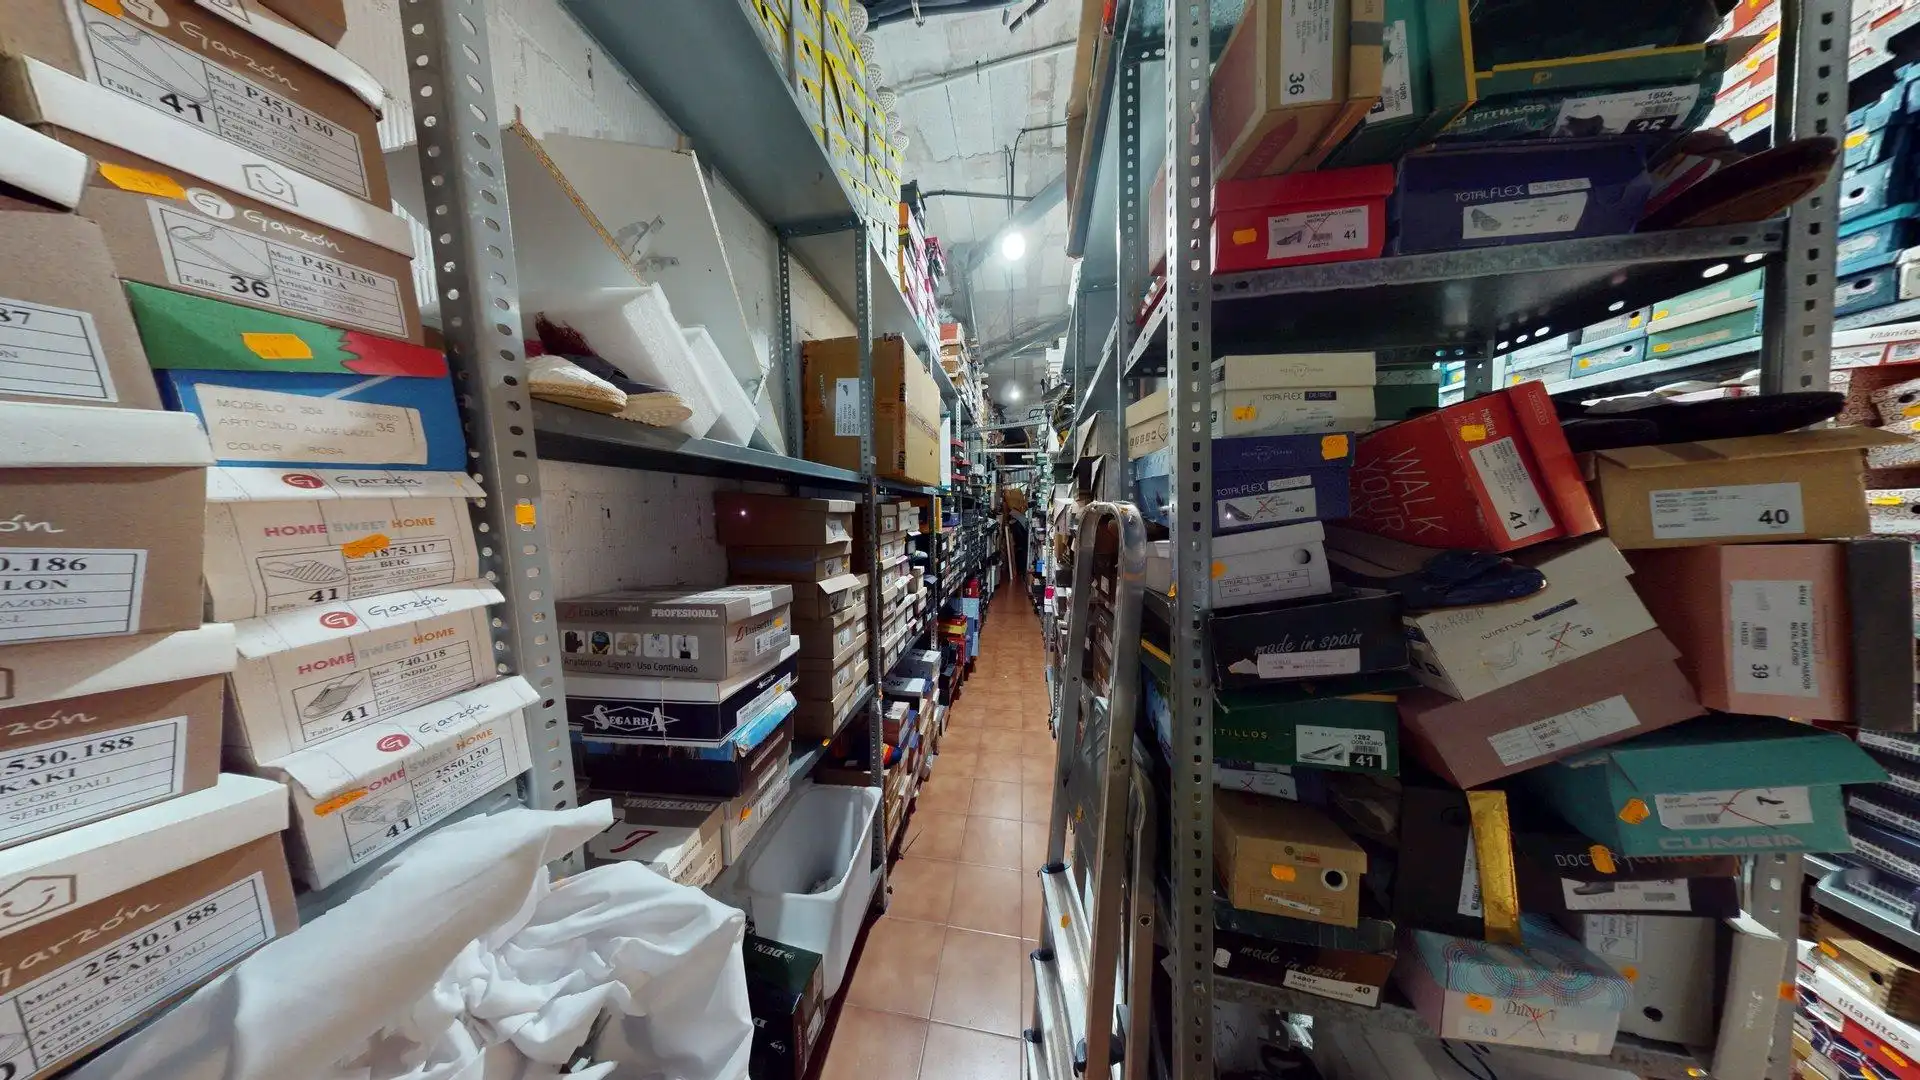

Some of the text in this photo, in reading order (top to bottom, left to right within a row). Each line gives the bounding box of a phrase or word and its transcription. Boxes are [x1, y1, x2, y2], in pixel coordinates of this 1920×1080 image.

[180, 21, 299, 92] Garzón
[1289, 72, 1305, 95] 36
[160, 93, 204, 123] 41
[246, 85, 333, 138] P451.130
[257, 105, 299, 134] LILA
[243, 209, 345, 253] Garzón
[1343, 230, 1357, 239] 41
[301, 255, 376, 287] P451.130
[312, 274, 348, 291] LILA
[230, 275, 270, 299] 36
[375, 422, 396, 434] 35
[226, 441, 346, 455] COLOR ROSA
[335, 474, 423, 489] Garzón
[1386, 447, 1449, 536] WALK
[1355, 457, 1406, 533] YOUR
[264, 517, 436, 537] HOME SWEET HOME
[1509, 511, 1528, 530] 41
[1757, 508, 1790, 525] 40
[371, 543, 436, 559] 1875.117
[379, 558, 410, 569] BEIG
[308, 587, 340, 603] 41
[368, 596, 448, 618] Garzón
[651, 608, 719, 618] PROFESIONAL
[1301, 634, 1315, 651] in
[1320, 627, 1363, 650] spain
[298, 627, 456, 675] HOME SWEET HOME
[397, 649, 447, 669] 740.118
[400, 664, 438, 680] INDIGO
[637, 662, 652, 671] Uso
[1751, 663, 1769, 679] 39
[341, 706, 369, 724] 41
[418, 702, 489, 733] Garzón
[592, 704, 668, 733] SEGARRA
[0, 735, 135, 776] 530.188
[367, 767, 406, 791] OME
[456, 728, 493, 750] HOME
[435, 747, 489, 779] 2550.120
[1355, 754, 1374, 767] 41
[0, 768, 77, 794] KAKI
[442, 760, 484, 785] MARINO
[385, 817, 413, 838] 41
[1658, 833, 1804, 850] CUMBIA
[84, 902, 218, 979] 2530.188
[102, 944, 173, 986] KAKI
[1240, 946, 1347, 980] made in spain
[1354, 986, 1371, 994] 40
[1837, 996, 1911, 1050] titanitos
